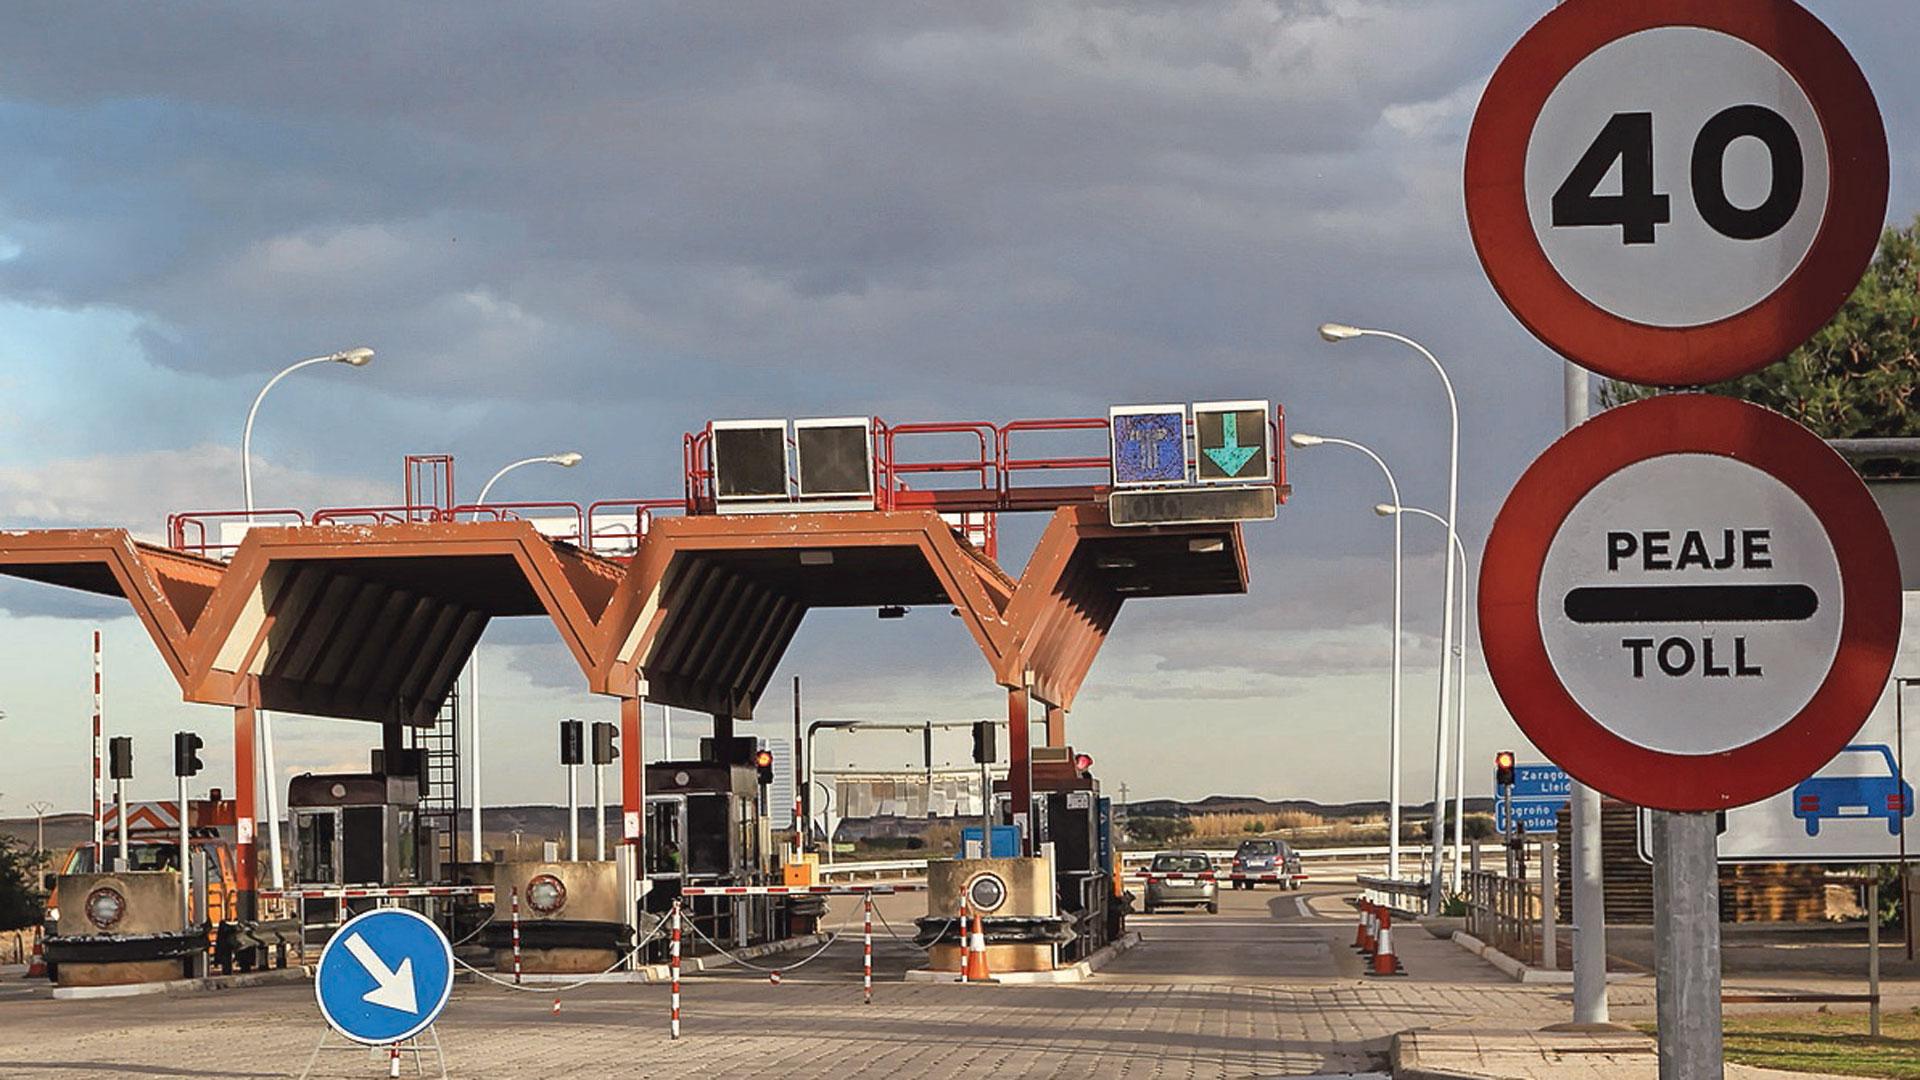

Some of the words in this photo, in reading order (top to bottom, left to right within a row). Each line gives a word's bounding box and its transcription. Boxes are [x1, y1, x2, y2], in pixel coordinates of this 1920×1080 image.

[1552, 105, 1803, 245] 40
[1608, 529, 1773, 571] PEAJE
[1622, 636, 1762, 678] TOLL
[1522, 770, 1570, 781] Zaragoz
